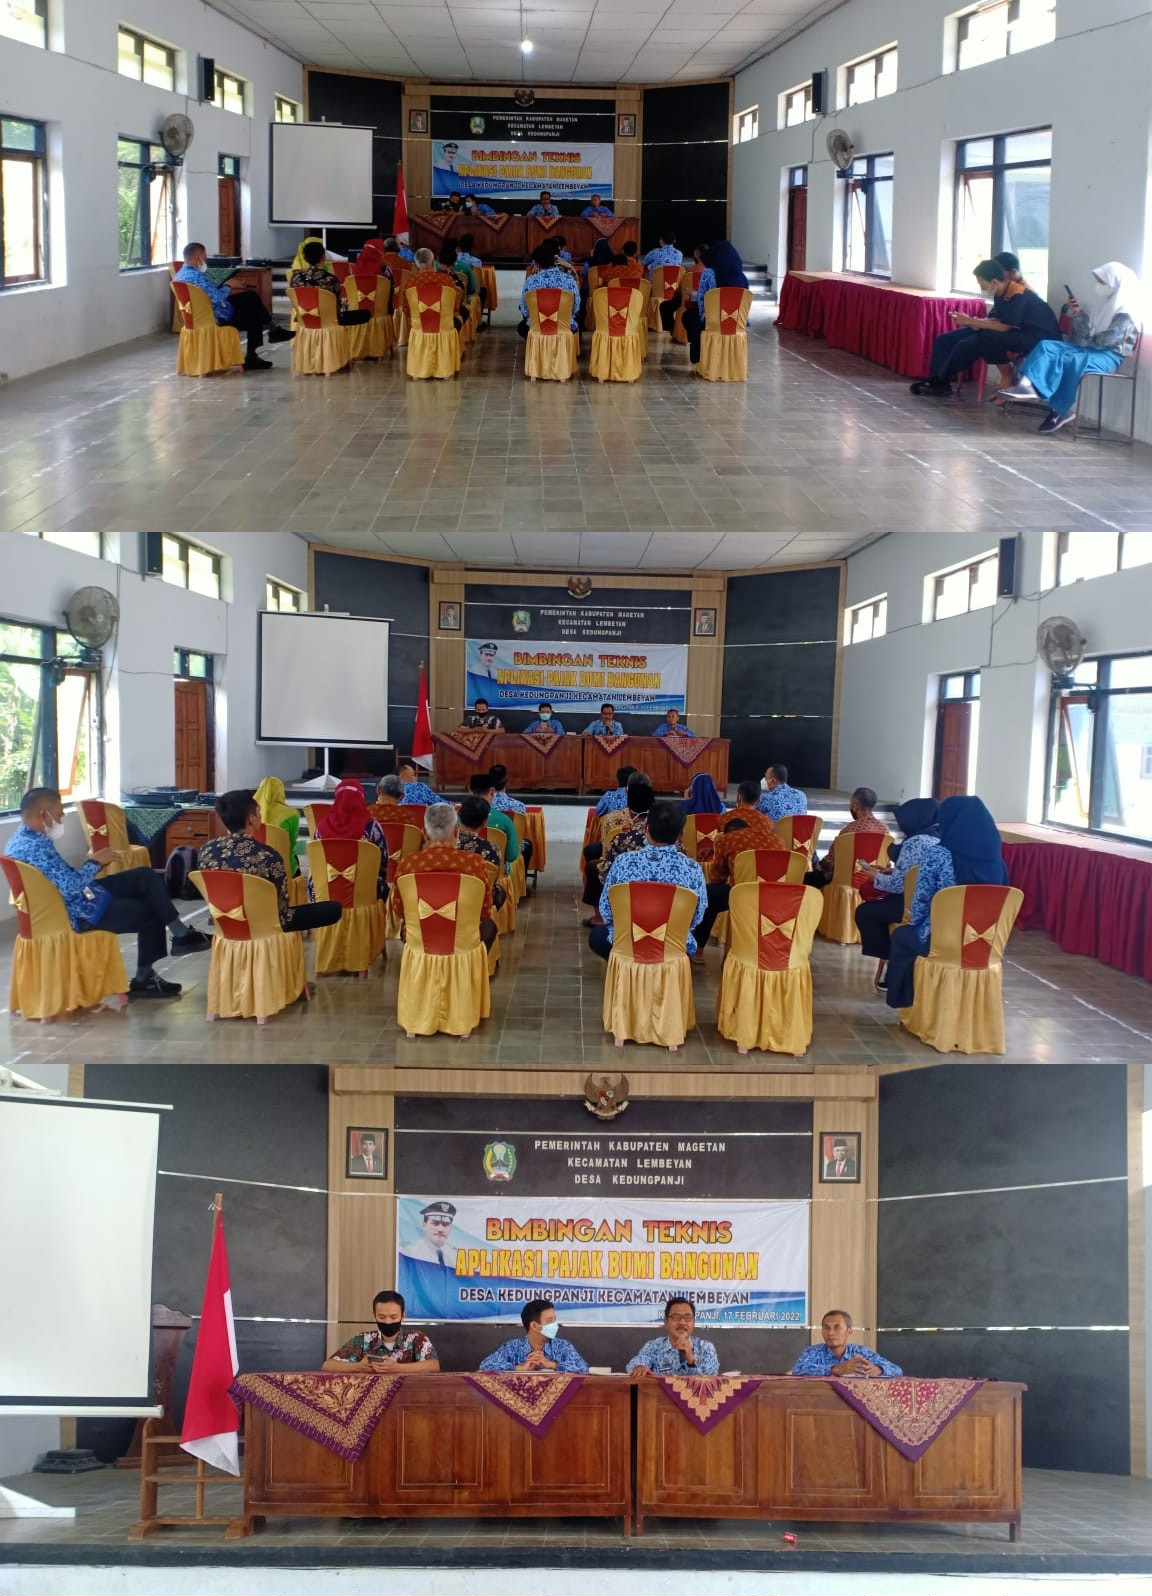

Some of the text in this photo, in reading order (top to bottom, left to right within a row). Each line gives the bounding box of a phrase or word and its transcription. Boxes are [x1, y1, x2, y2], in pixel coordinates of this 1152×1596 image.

[471, 150, 582, 164] BIMBINGAN TEKNIS
[458, 163, 498, 178] APLIKASI
[526, 165, 547, 179] BUMI
[549, 165, 593, 180] BANGUNAN
[513, 652, 647, 669] BIMBINGAN TEKNIS
[497, 668, 661, 689] APLIKASI PAJAK BUMI BANGUNAN
[499, 690, 655, 701] DESA KEDUNGPANJI KECAMATAN LEMBEYAN
[534, 1140, 726, 1152] PEMERINTAH KABUPATEN MAGETAN
[567, 1158, 693, 1169] KECAMATAN LEMBEYAN
[574, 1174, 685, 1185] DESA KEDUNGPANJI
[485, 1217, 733, 1244] BIMBINGAN TEKNIS
[455, 1248, 760, 1281] APLIKASI PAJAK BUMI BANGUNAN
[459, 1287, 494, 1301] DESA
[498, 1287, 594, 1304] KEDUNGPANJI
[598, 1288, 678, 1304] KECAMATAN
[724, 1311, 733, 1321] 17
[735, 1312, 779, 1321] FEBRUARI
[780, 1312, 800, 1321] 2022
